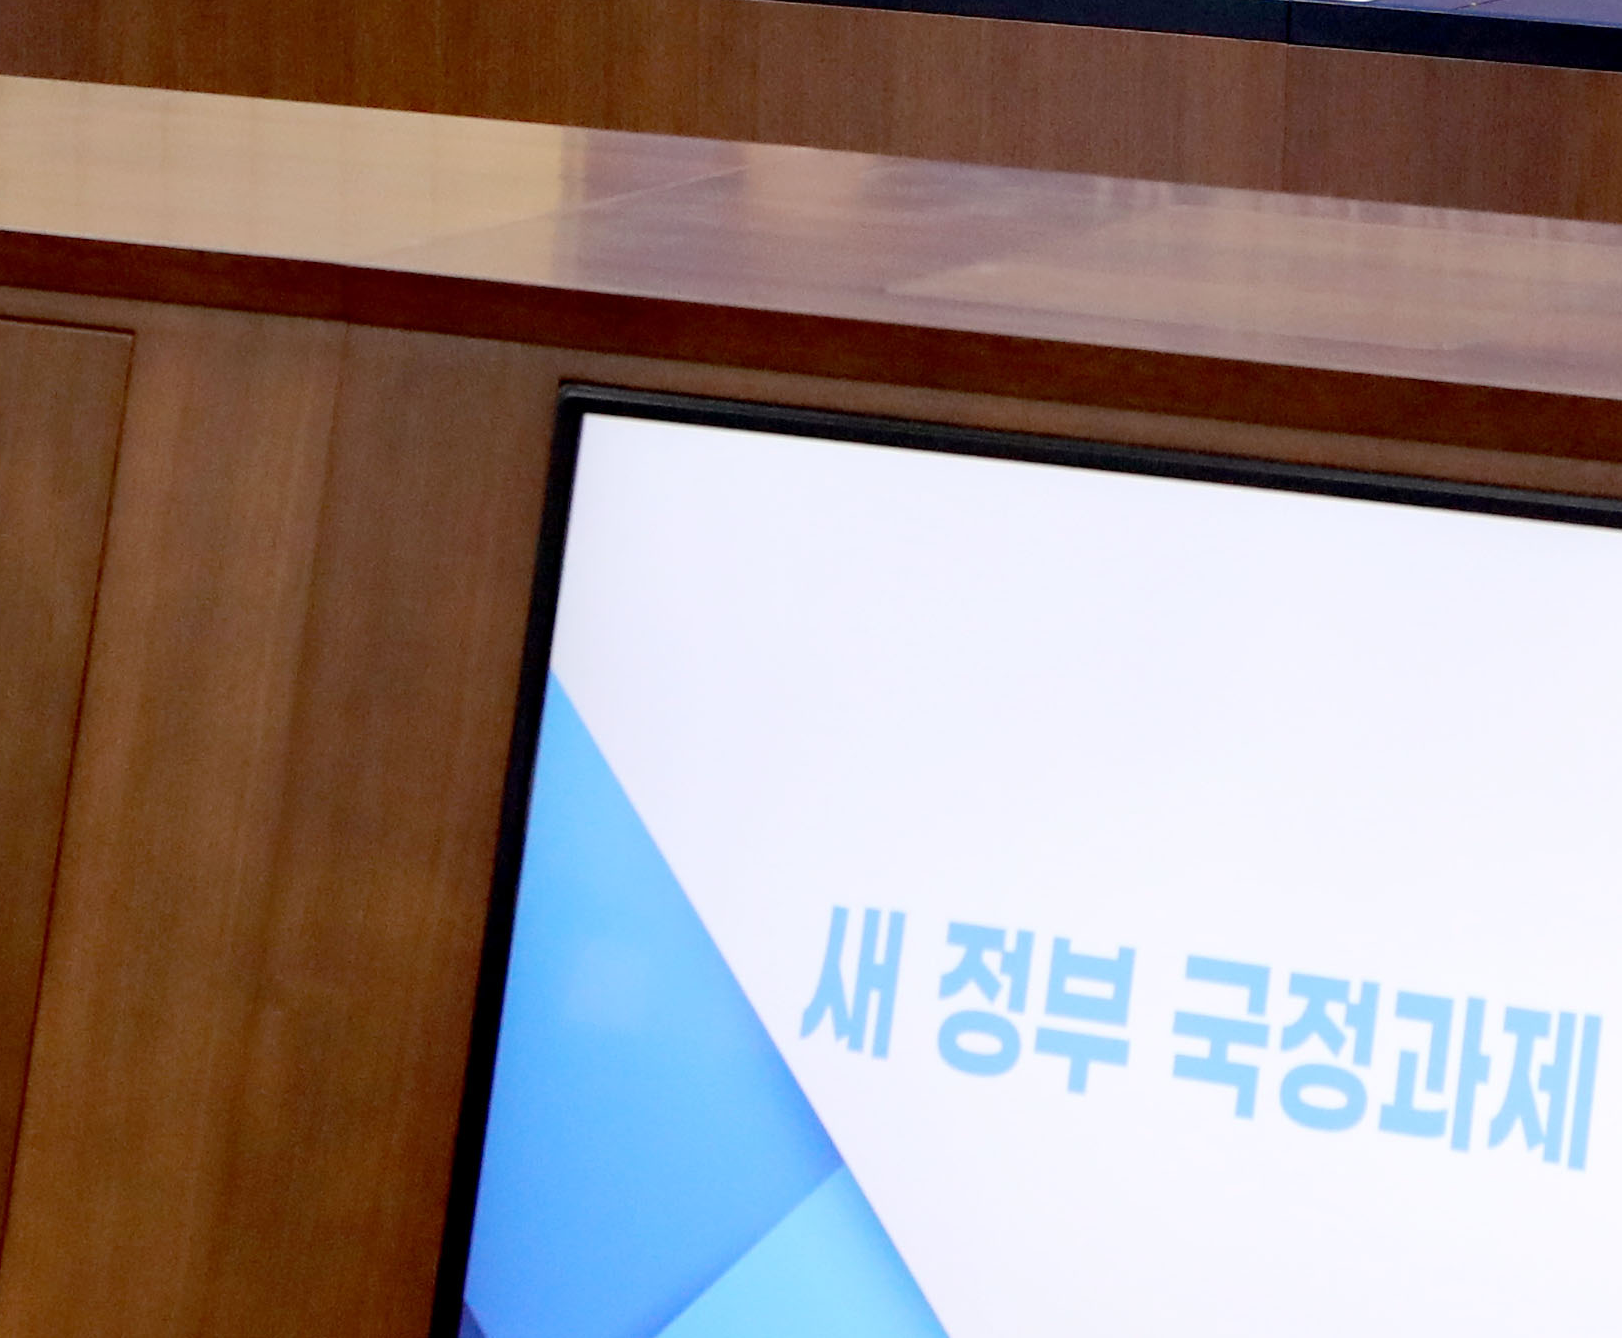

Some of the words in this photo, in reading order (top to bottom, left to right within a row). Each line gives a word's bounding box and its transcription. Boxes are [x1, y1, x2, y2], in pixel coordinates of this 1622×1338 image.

[798, 905, 908, 1060] 새
[935, 920, 1137, 1097] 정부
[1170, 953, 1603, 1173] 국정과제
